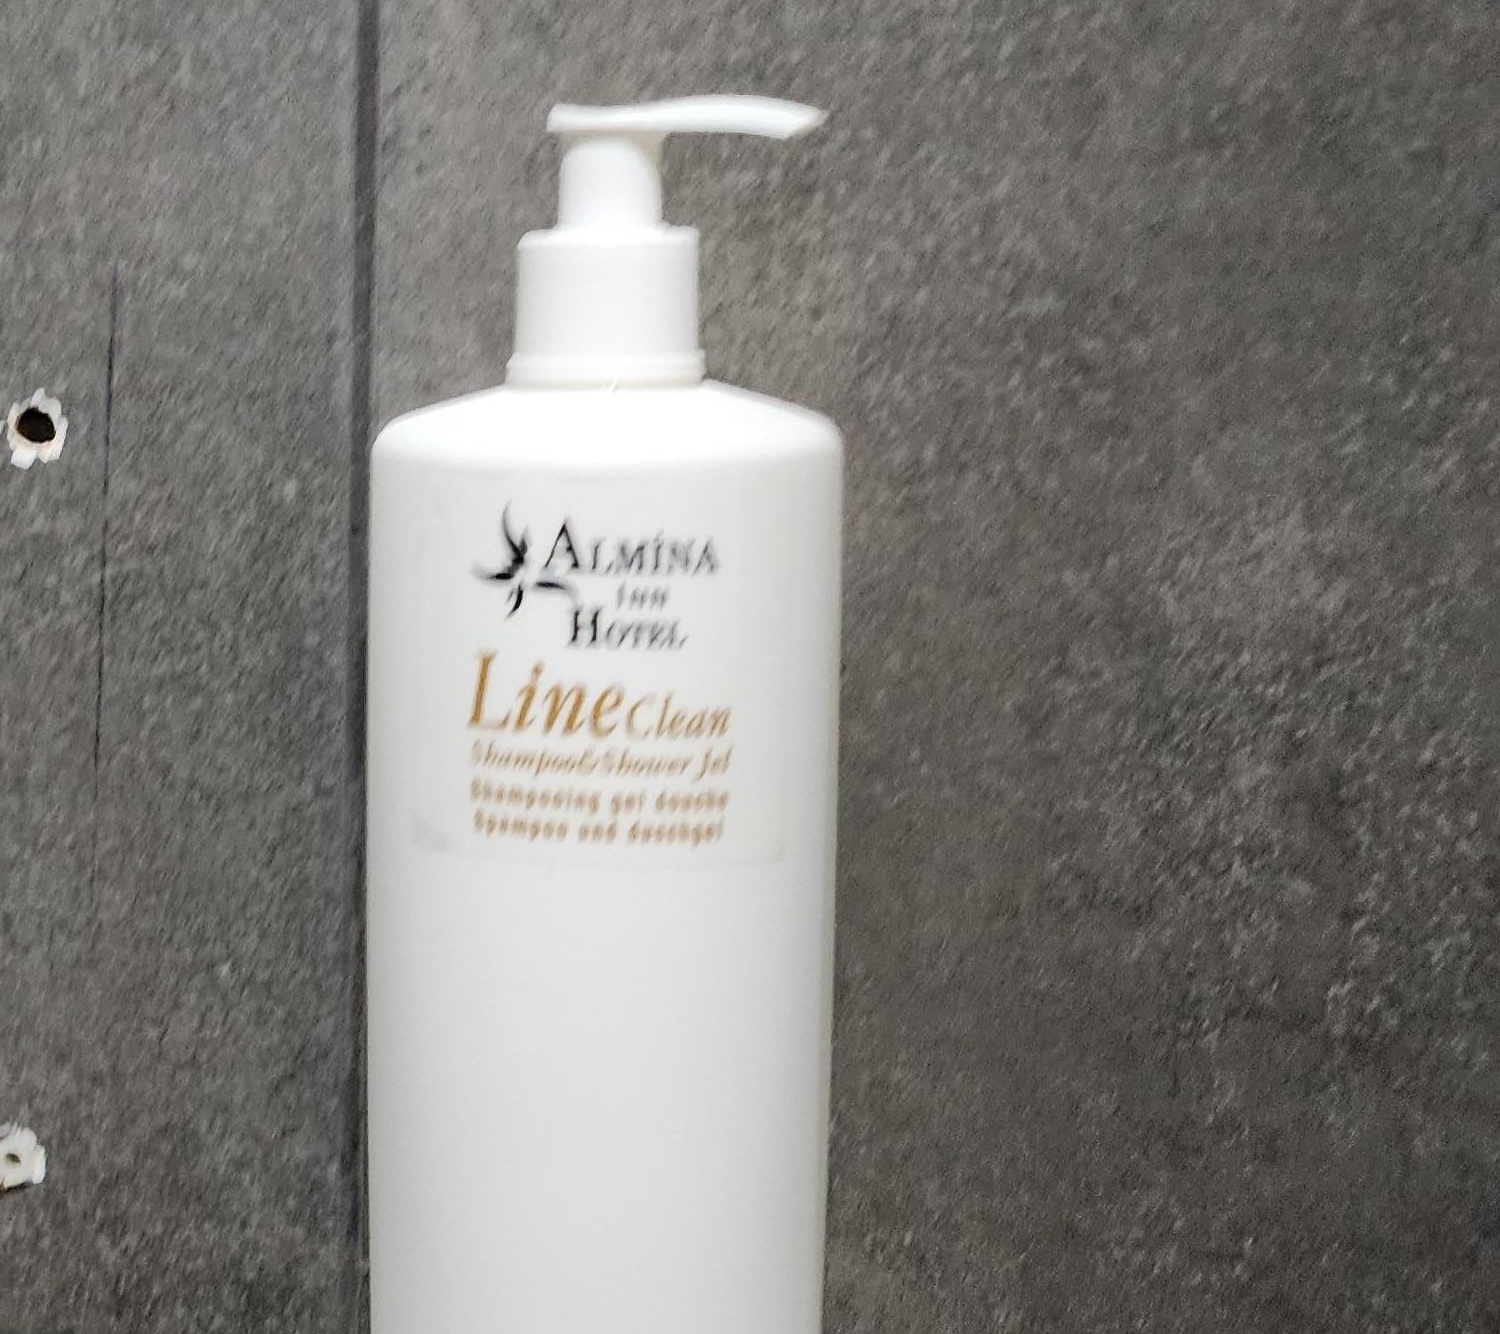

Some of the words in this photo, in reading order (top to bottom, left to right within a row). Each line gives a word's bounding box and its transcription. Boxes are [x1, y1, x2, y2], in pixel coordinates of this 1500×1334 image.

[566, 605, 688, 650] HOTEL
[466, 650, 626, 739] Line
[625, 692, 734, 740] Clean
